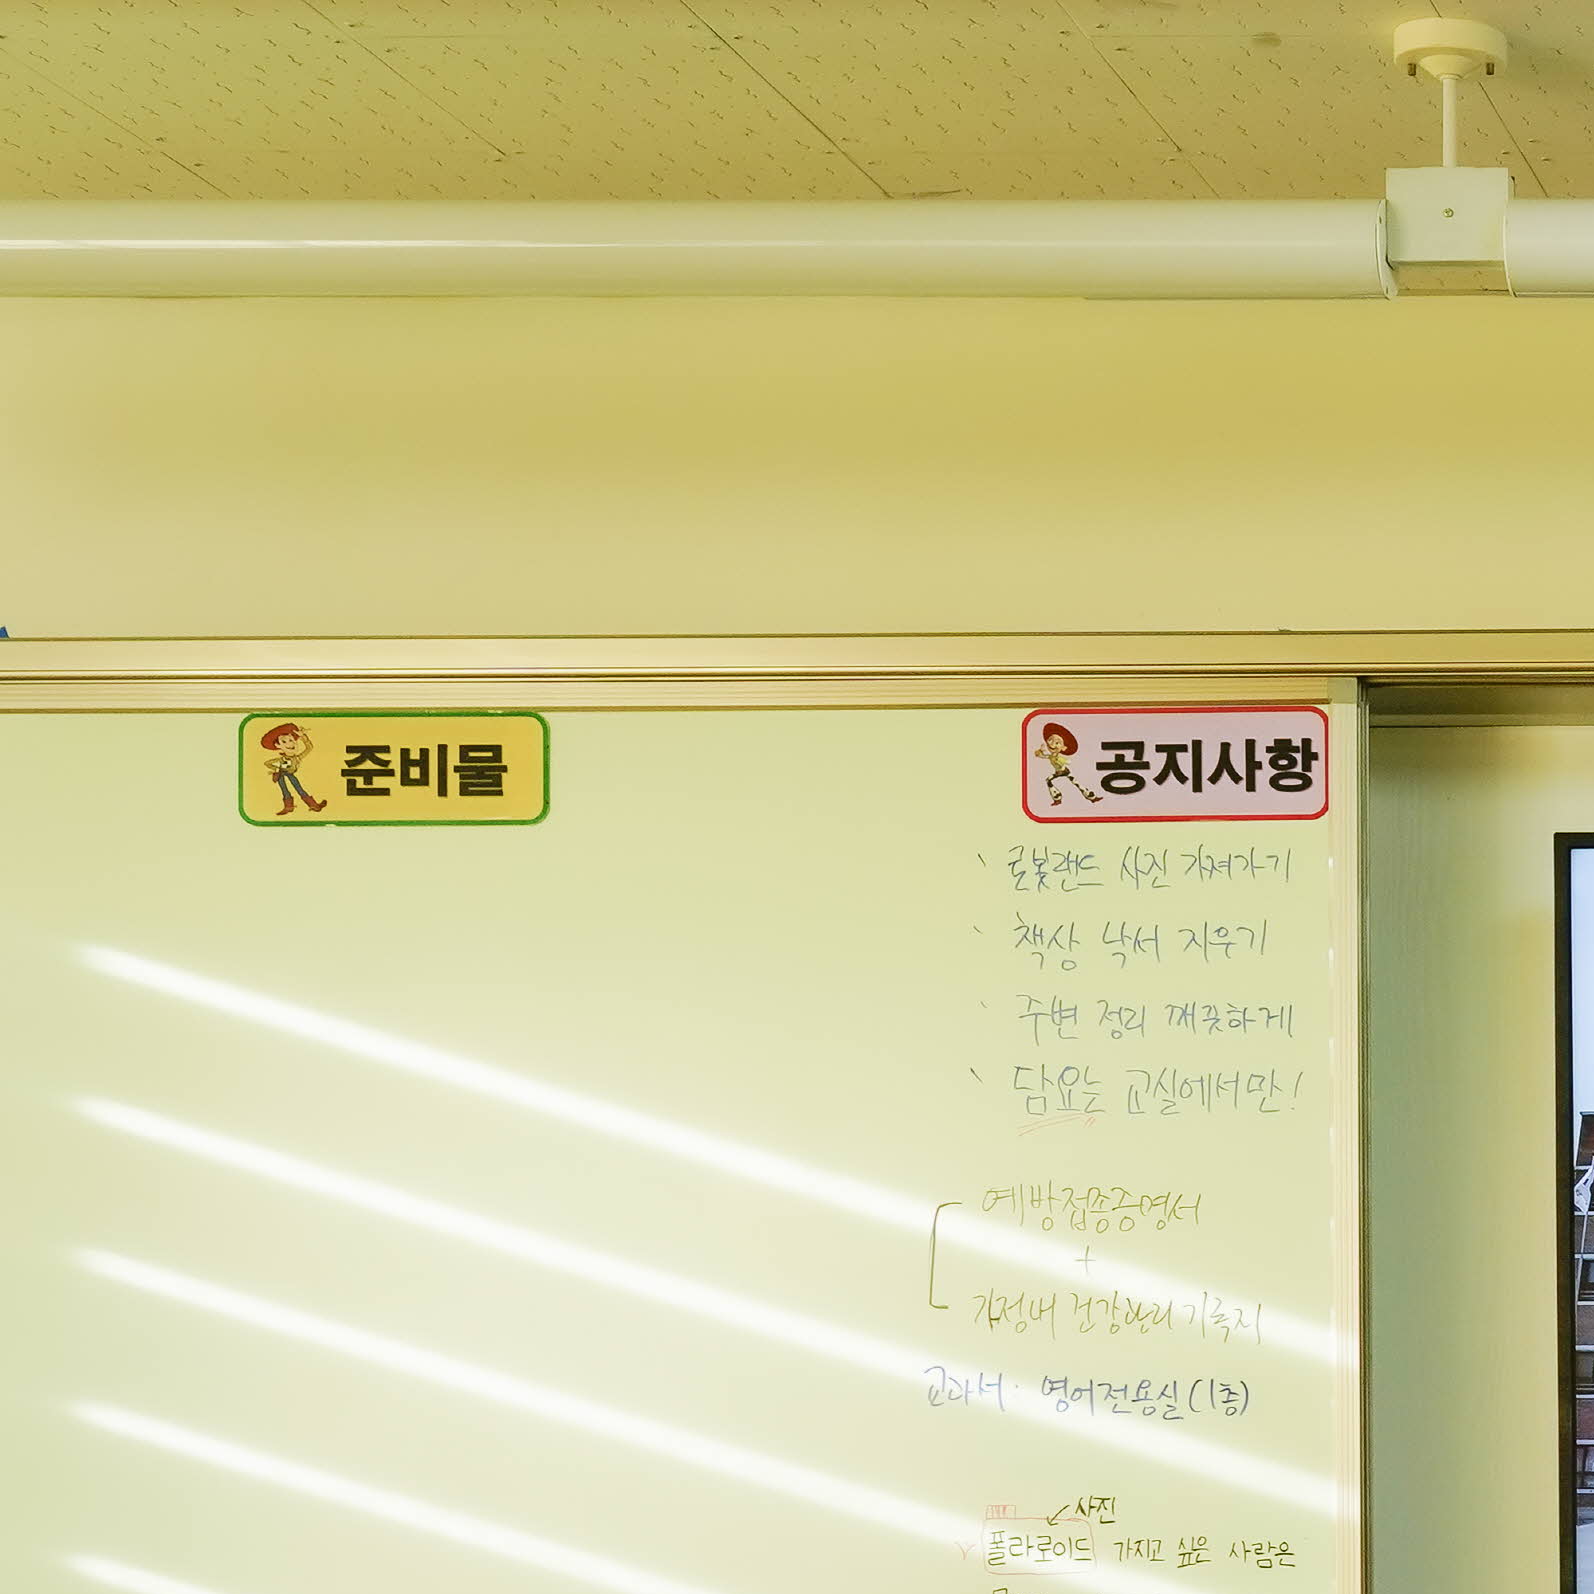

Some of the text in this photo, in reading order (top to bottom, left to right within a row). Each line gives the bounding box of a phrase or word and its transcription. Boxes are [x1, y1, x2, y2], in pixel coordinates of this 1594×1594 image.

[340, 743, 509, 798] 준비물
[1095, 737, 1319, 795] 공지사항
[1120, 844, 1171, 890] 사진
[1180, 843, 1291, 884] 가져가기
[1012, 911, 1268, 971] 책상 낙서 지우기
[1015, 994, 1081, 1047] 주변
[1096, 999, 1146, 1040] 정리
[1013, 1062, 1107, 1116] 담요는
[1188, 1290, 1262, 1345] 기록지
[1074, 1495, 1117, 1525] 사진
[987, 1529, 1296, 1569] 폴라로이드 가지고 싶은 사람은
